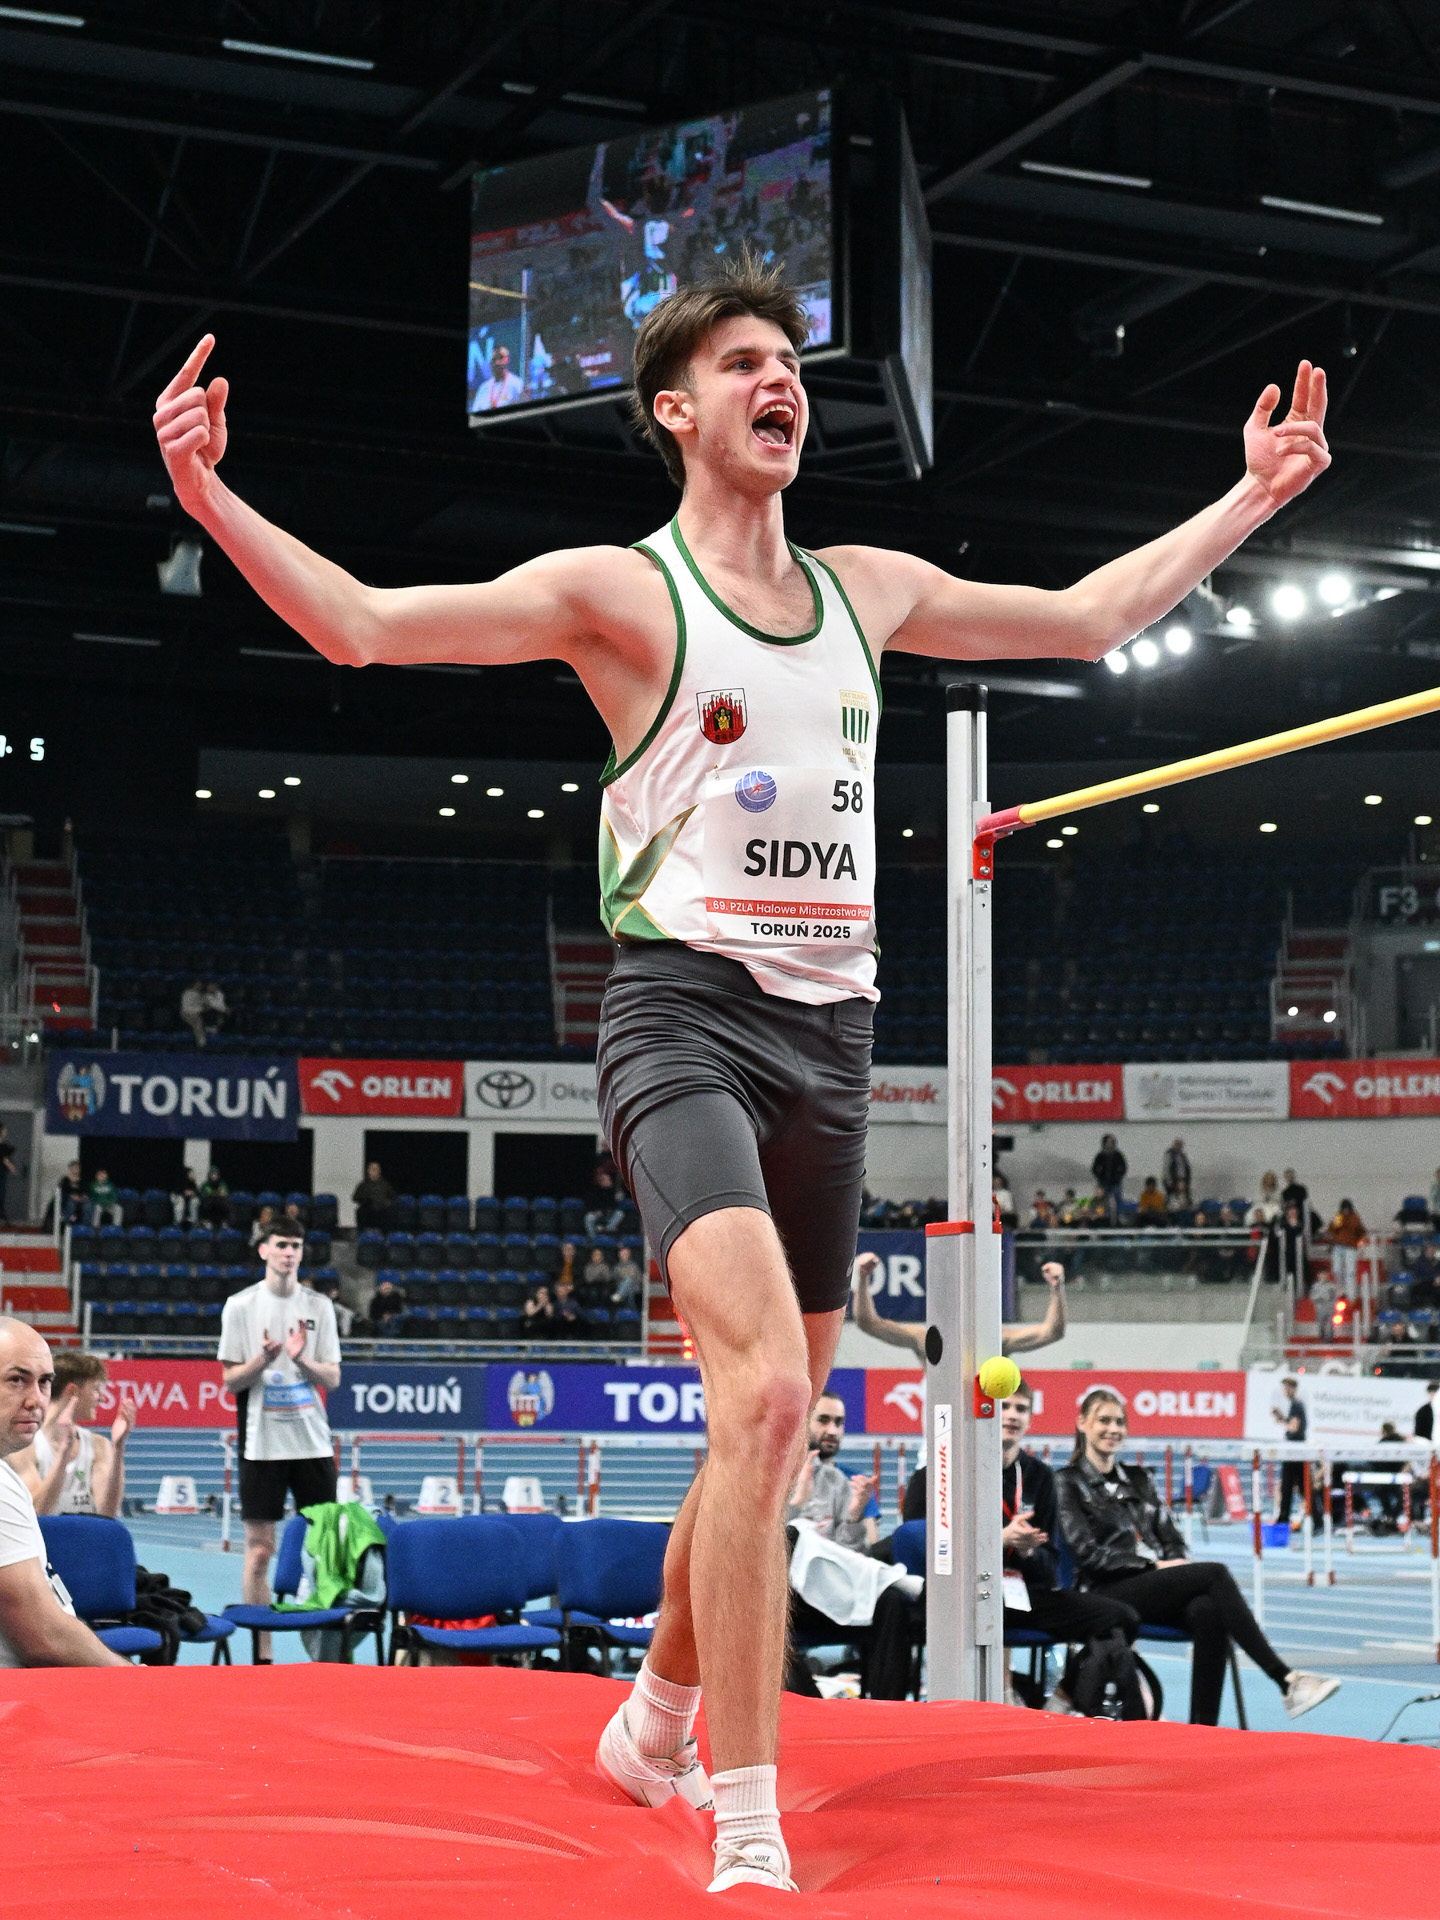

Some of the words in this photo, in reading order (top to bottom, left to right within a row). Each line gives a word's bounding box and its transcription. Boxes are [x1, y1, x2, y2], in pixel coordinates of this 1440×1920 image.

[831, 779, 864, 813] 58
[743, 838, 858, 881] SIDYA
[712, 900, 729, 911] 69.
[730, 902, 754, 913] PZLA
[757, 903, 796, 915] Halowe
[799, 905, 857, 917] Mistrzostwa
[1380, 886, 1419, 916] F3
[751, 920, 809, 938] TORUŃ
[812, 925, 851, 939] 2025
[110, 1067, 288, 1119] TORUŃ
[361, 1075, 452, 1099] ORLEN
[1023, 1080, 1113, 1104] ORLEN
[1352, 1075, 1440, 1100] ORLEN
[351, 1376, 462, 1415] TORUŃ
[1133, 1390, 1237, 1418] ORLEN
[438, 1485, 451, 1504] 2
[523, 1485, 532, 1503] 1
[938, 1443, 949, 1529] polanik
[754, 1854, 770, 1863] NIKE
